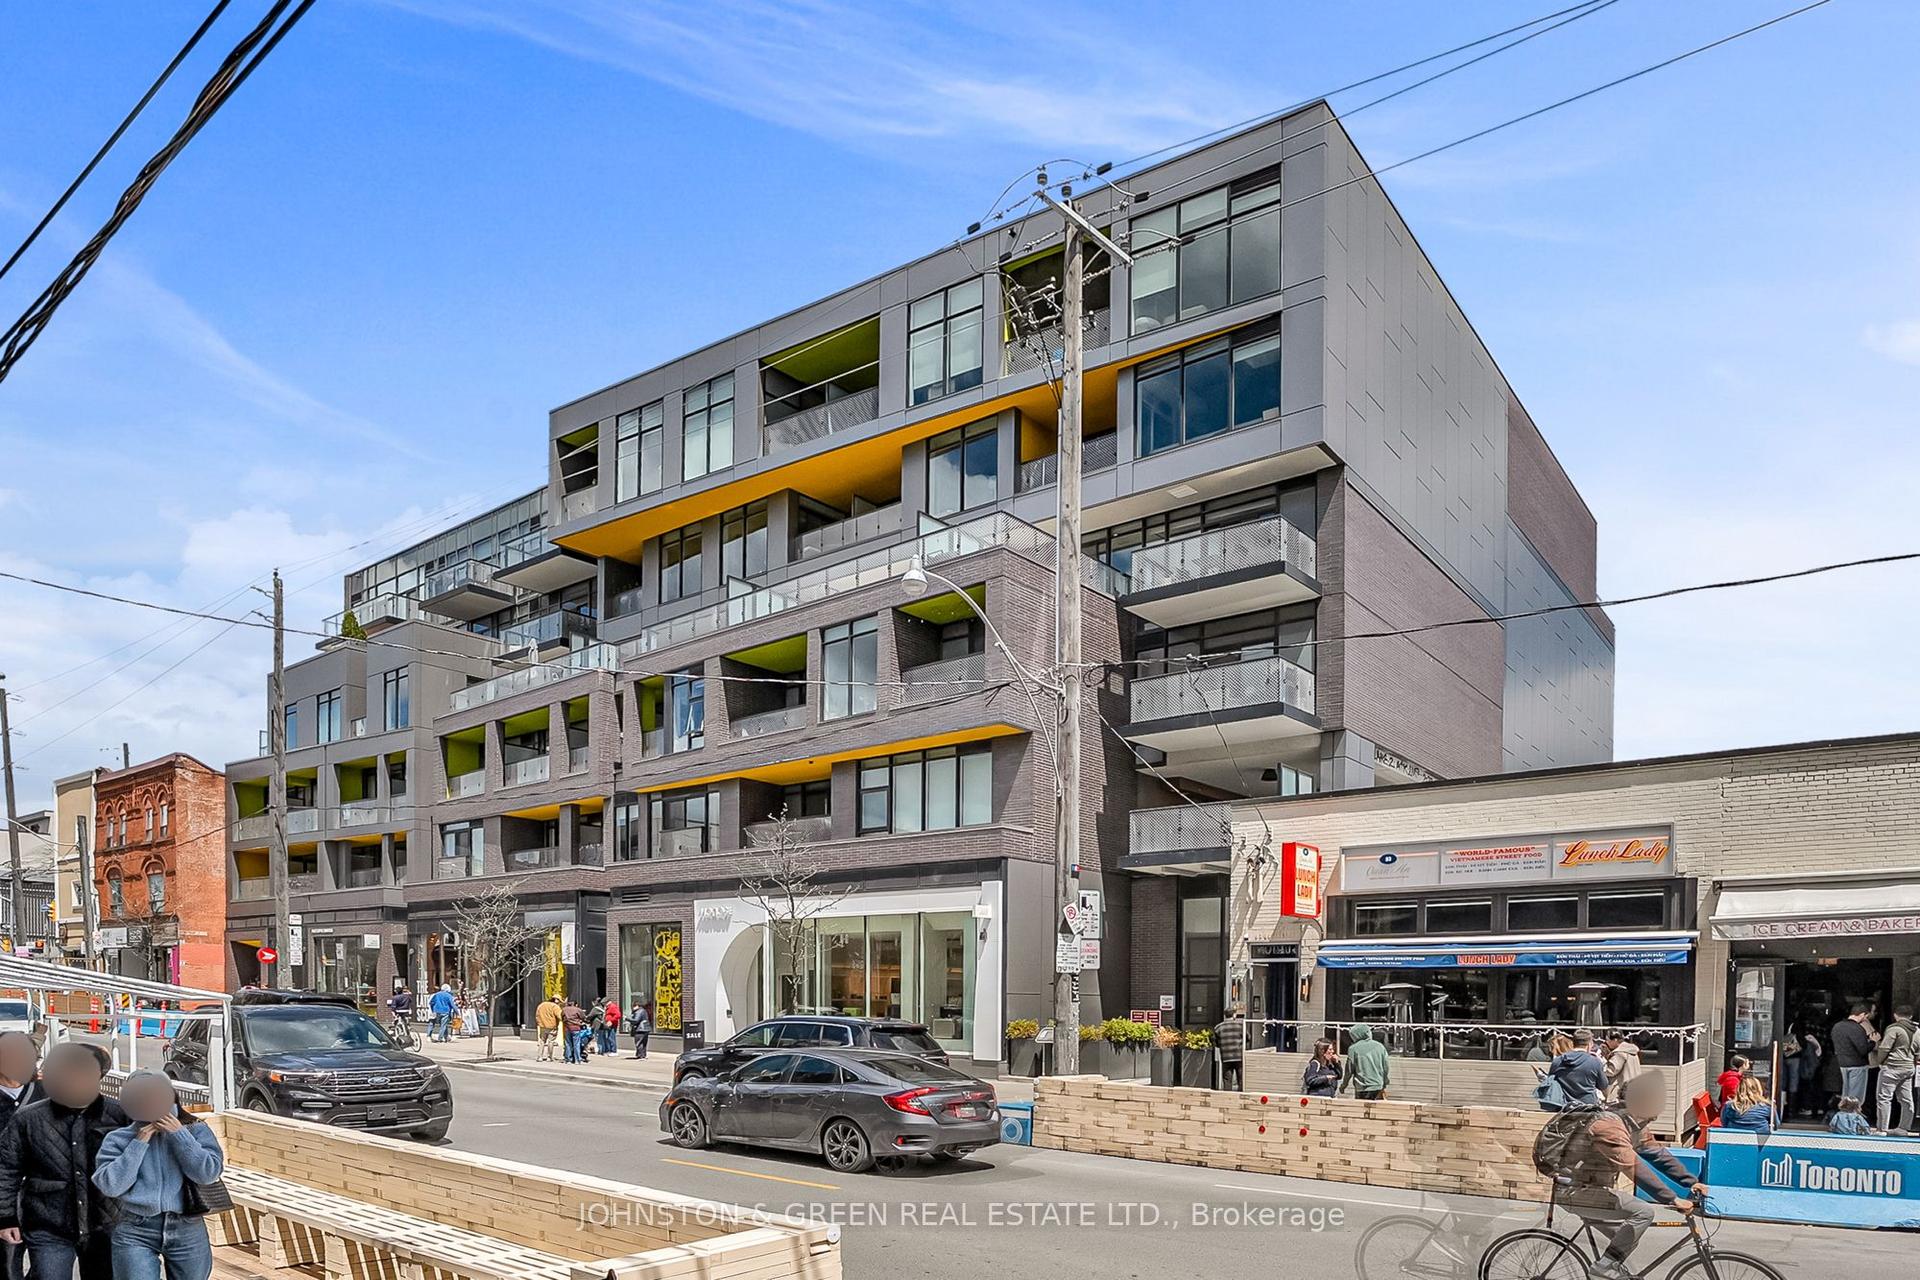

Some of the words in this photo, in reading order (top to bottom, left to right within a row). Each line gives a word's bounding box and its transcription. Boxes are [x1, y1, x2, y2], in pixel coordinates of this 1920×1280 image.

[1450, 855, 1494, 863] VIETNAMESE
[1559, 840, 1618, 867] Lunch
[1617, 840, 1669, 864] Lady
[1752, 923, 1779, 935] ICE
[1785, 921, 1843, 934] CREAM
[1850, 920, 1862, 931] &
[1458, 954, 1489, 964] LUNCH
[1490, 954, 1515, 964] LADY
[416, 980, 429, 993] THE
[1796, 1159, 1902, 1196] TORONTO
